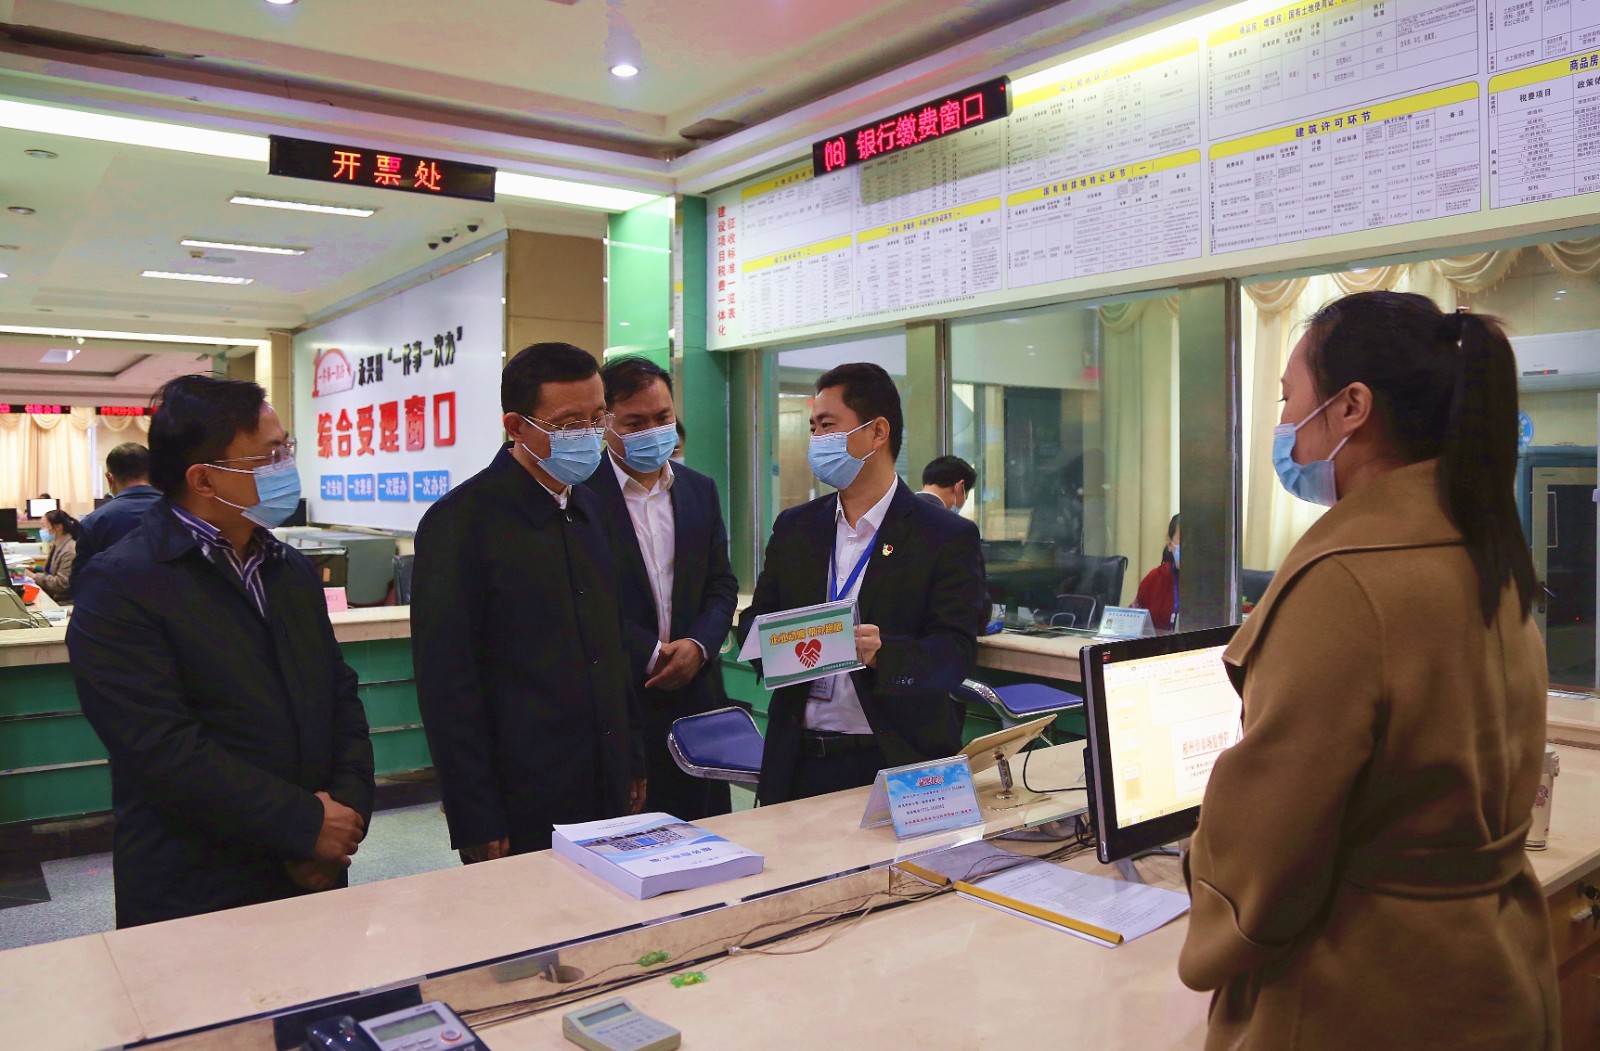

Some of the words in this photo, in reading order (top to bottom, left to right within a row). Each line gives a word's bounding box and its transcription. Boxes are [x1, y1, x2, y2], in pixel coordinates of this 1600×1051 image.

[1569, 54, 1599, 71] 商品房
[1520, 88, 1551, 102] 税费项目
[856, 92, 985, 160] 银行缴费窗口
[1295, 111, 1372, 138] 建筑许可环节
[332, 150, 442, 190] 开票处
[717, 205, 726, 336] 建设项目税费一体化
[727, 217, 736, 319] 征收标准一览表
[317, 391, 456, 458] 综合受理窗口
[415, 476, 448, 497] 一次办好
